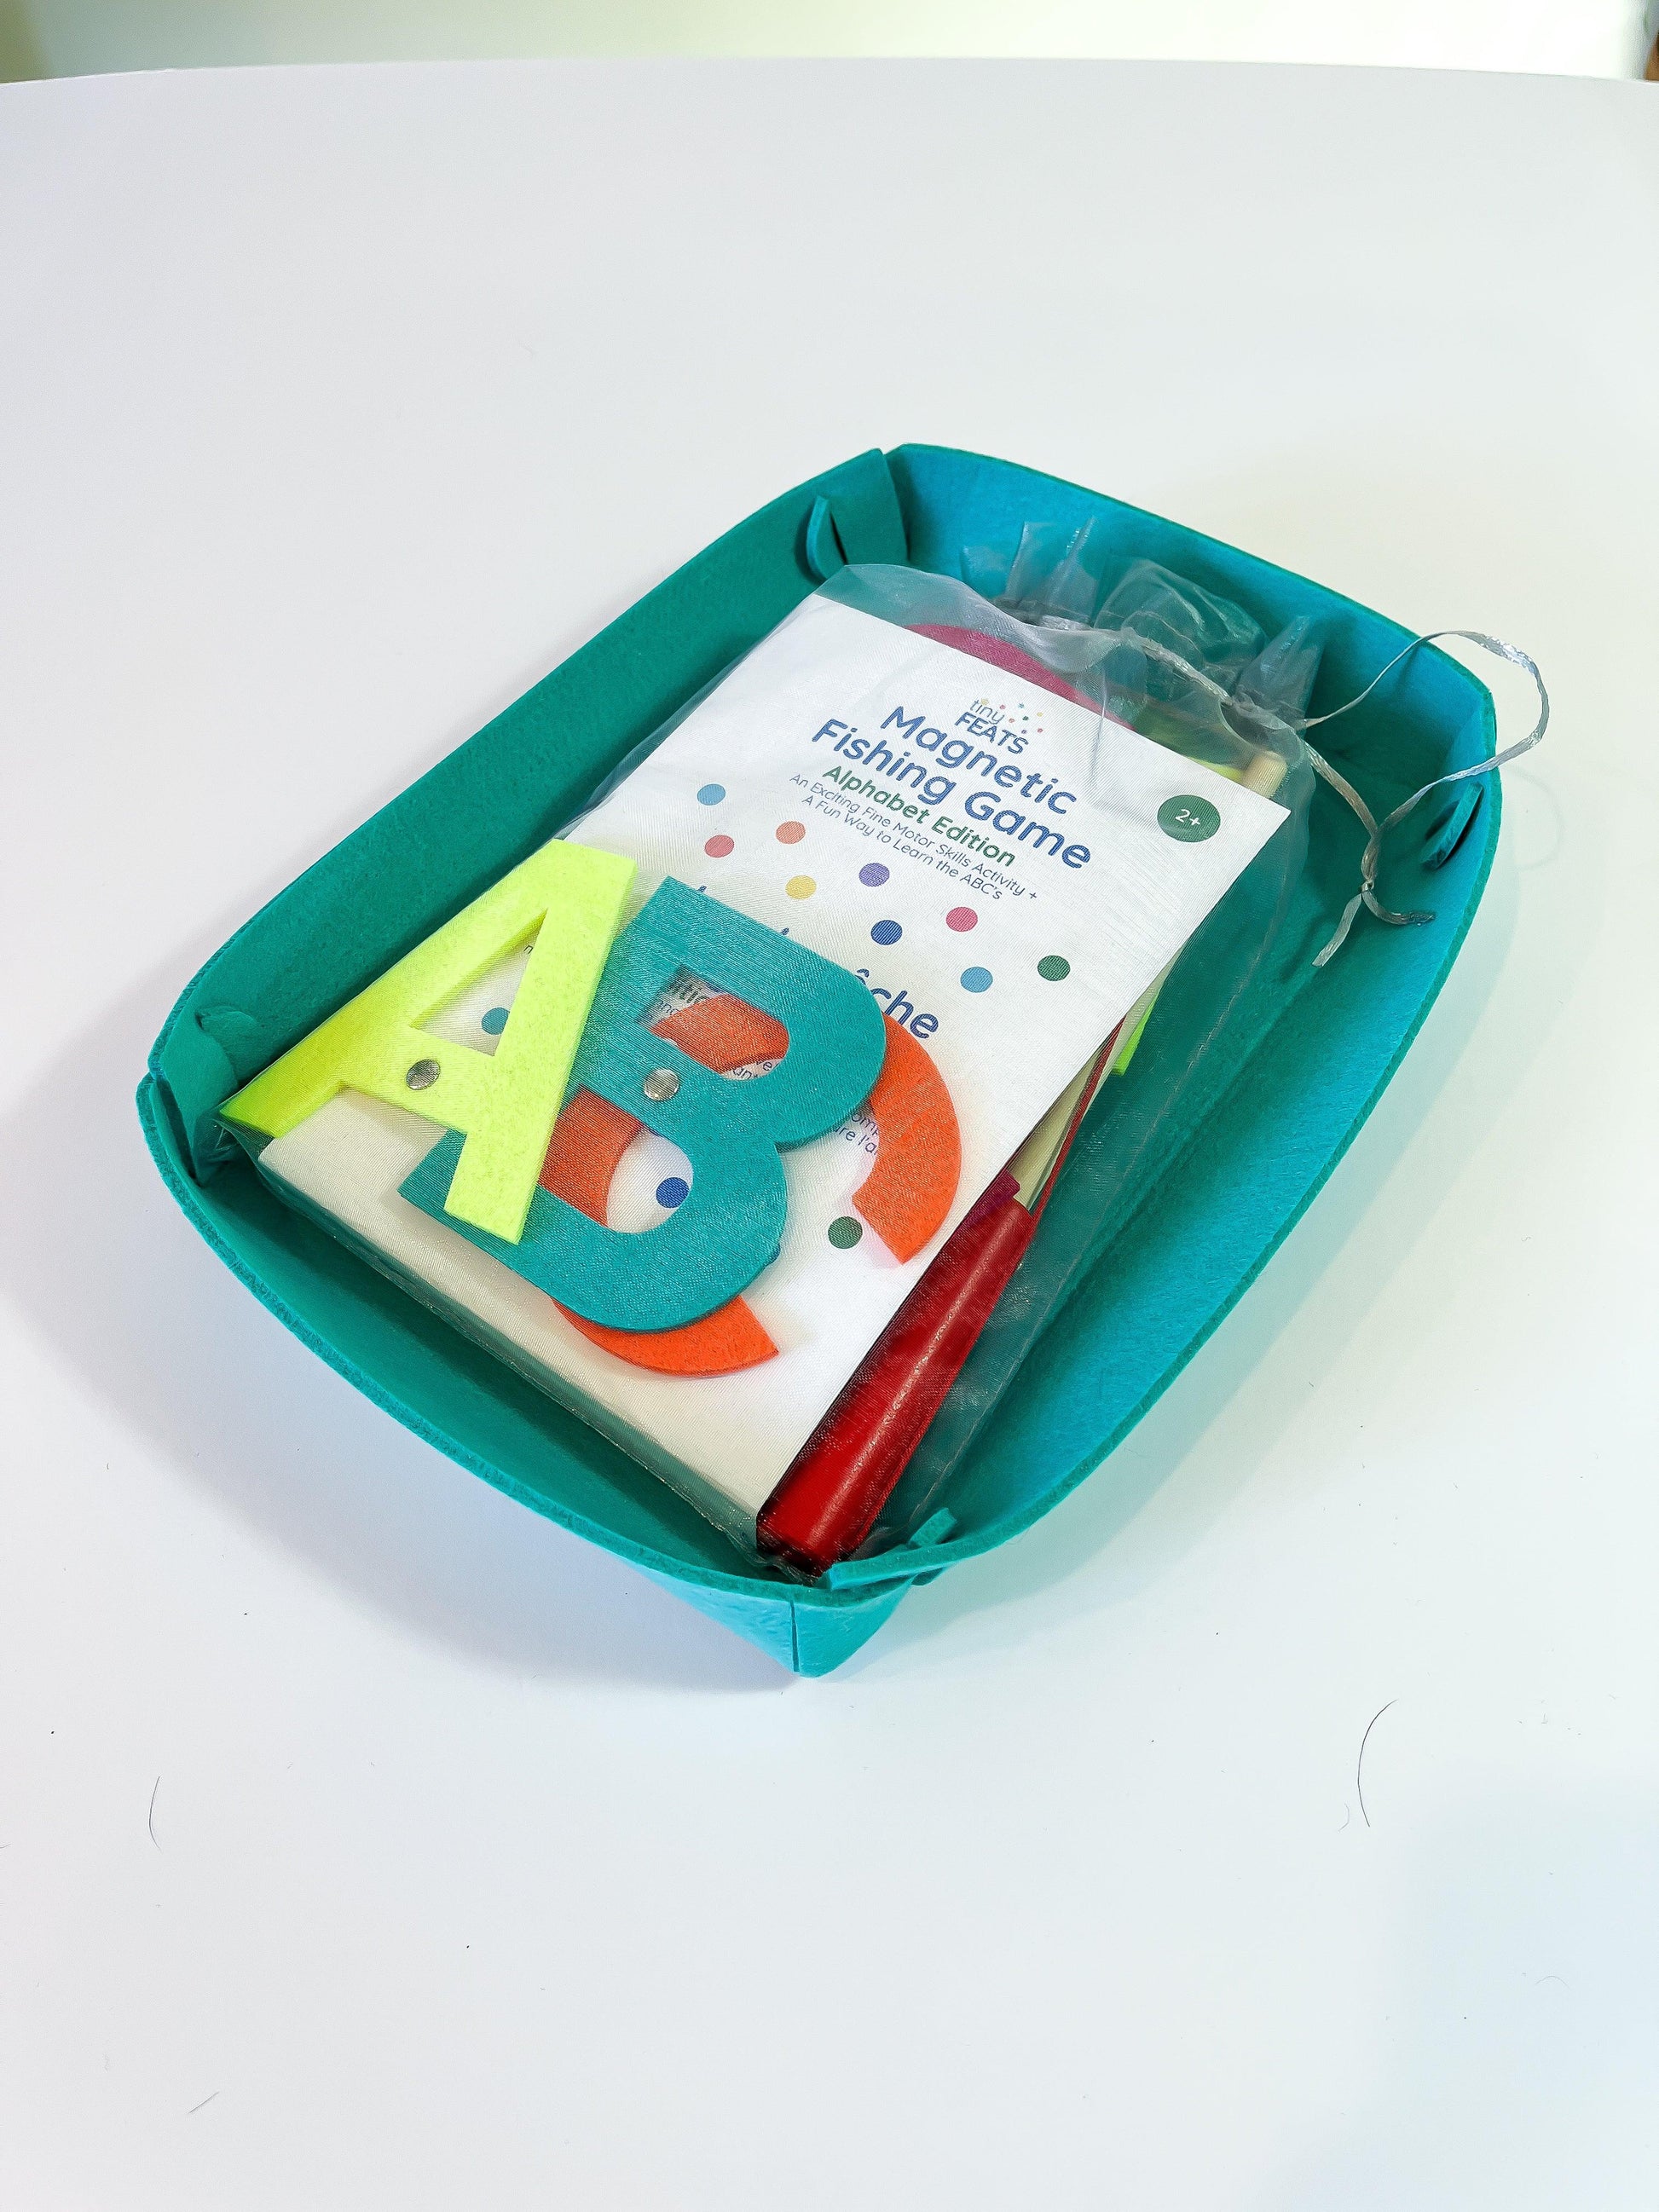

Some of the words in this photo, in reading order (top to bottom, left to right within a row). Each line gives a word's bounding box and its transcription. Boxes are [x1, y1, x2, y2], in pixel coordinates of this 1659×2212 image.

[880, 706, 1077, 814] Magnetic
[954, 711, 1029, 754] FEATS
[969, 700, 1004, 725] tiny
[789, 774, 808, 788] An
[810, 782, 860, 813] Exciting
[862, 806, 891, 828] Fine
[893, 823, 935, 848] Motor
[935, 844, 971, 868] Skills
[972, 863, 1026, 897] Activity
[812, 719, 957, 806] Fishing
[964, 791, 1091, 869] Game
[822, 765, 930, 824] Alphabet
[931, 816, 1015, 867] Edition
[1175, 808, 1200, 826] 2+
[801, 795, 814, 806] A
[815, 800, 841, 818] Fun
[844, 813, 876, 837] Way
[876, 830, 892, 843] to
[893, 839, 934, 865] Learn
[935, 860, 959, 878] the
[960, 874, 1003, 900] ABC's
